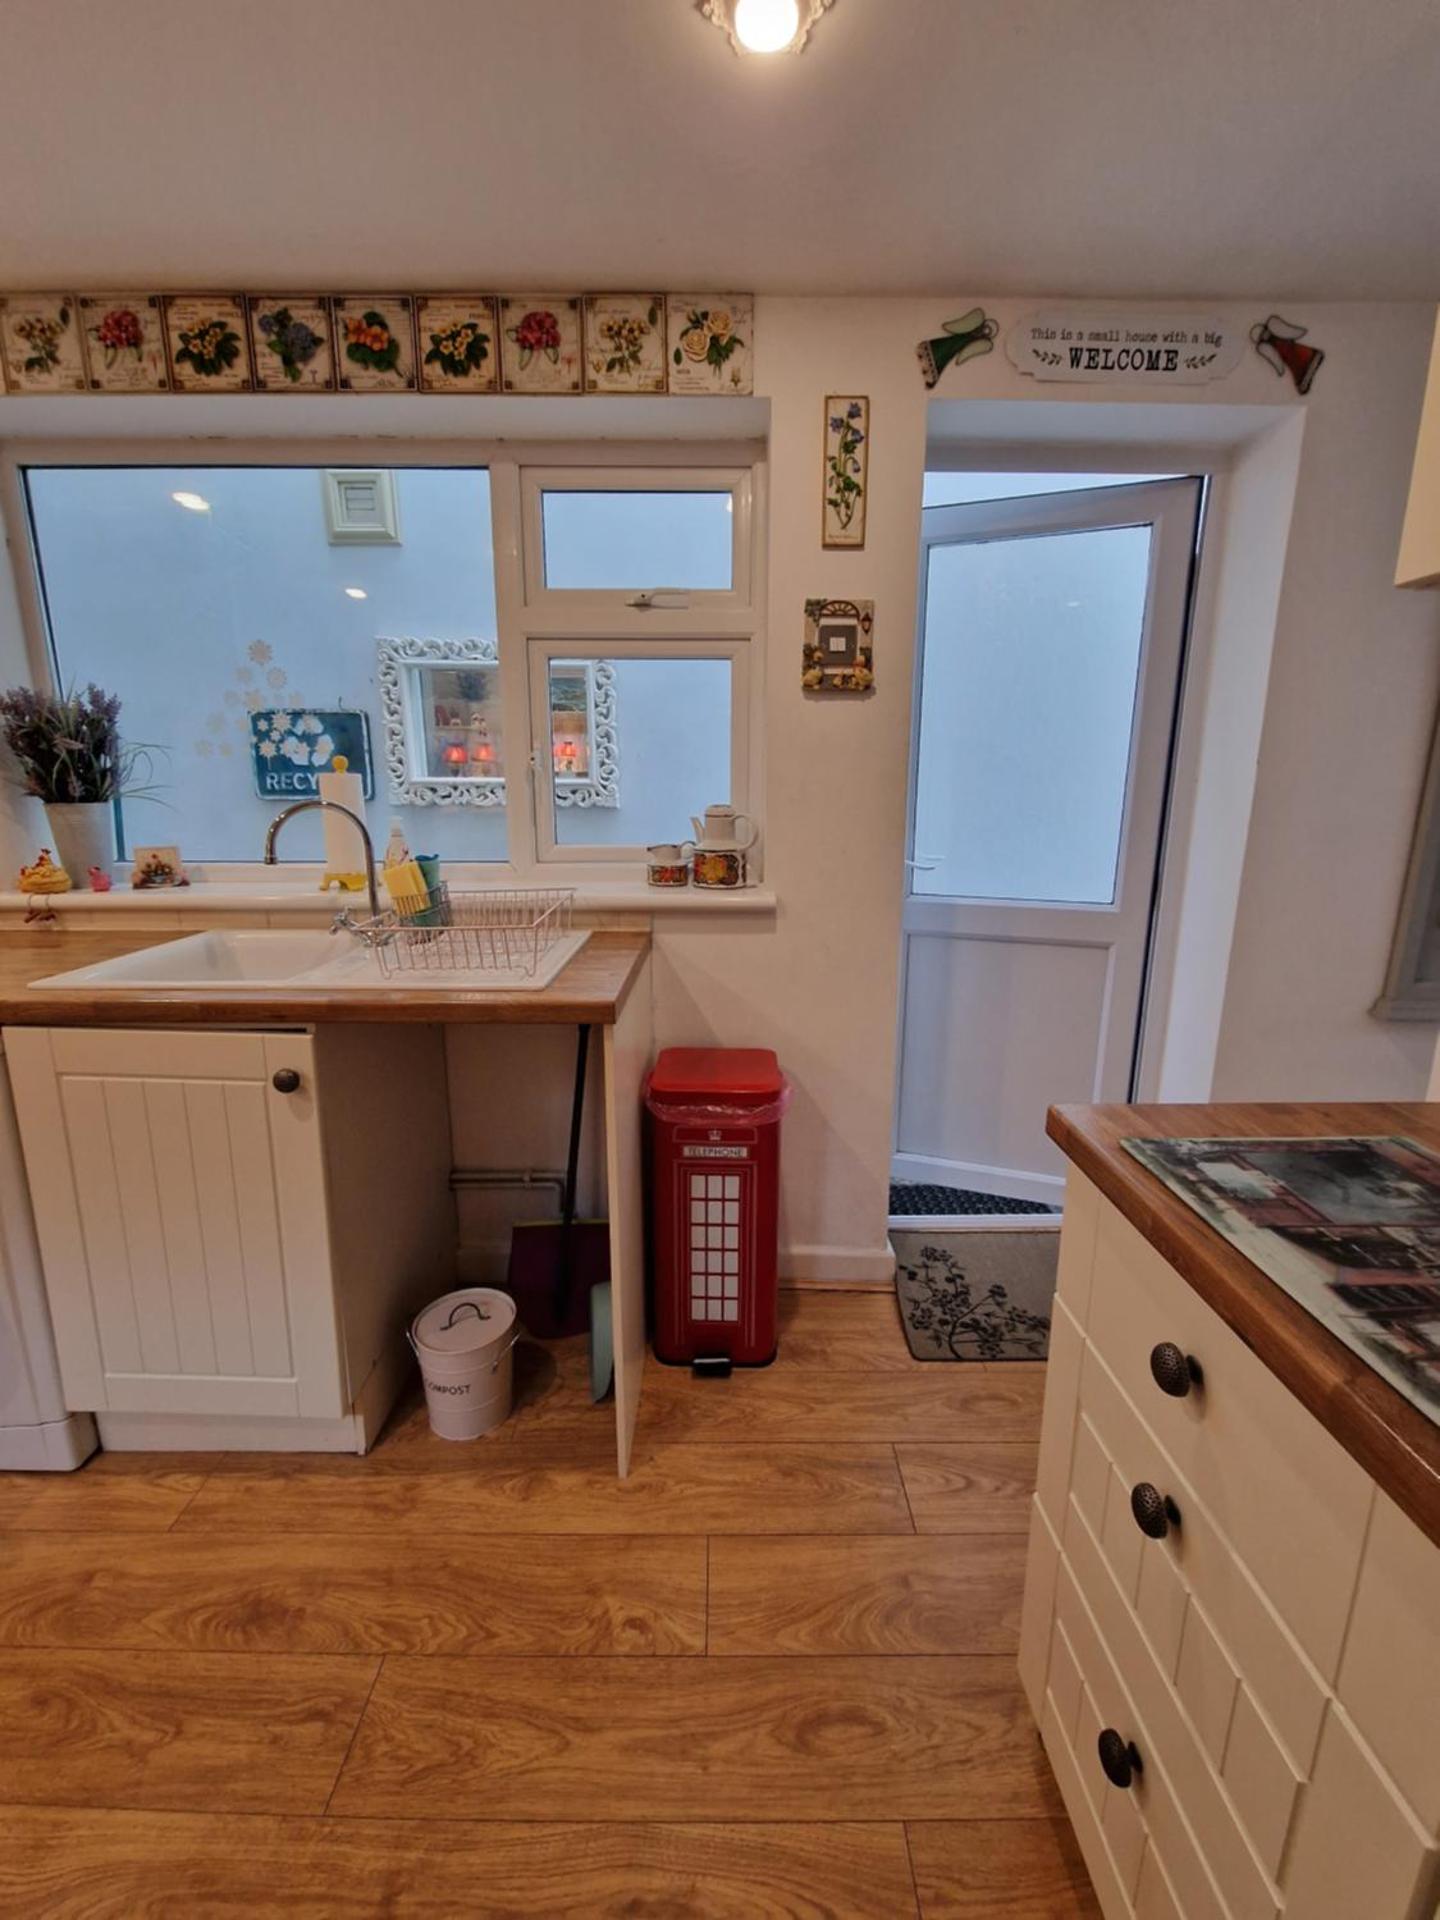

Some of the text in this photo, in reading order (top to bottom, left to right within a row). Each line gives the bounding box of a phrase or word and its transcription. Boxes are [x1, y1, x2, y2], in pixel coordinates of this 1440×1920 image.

[1031, 328, 1223, 348] This is a small house with a big
[1068, 347, 1179, 371] WELCOME
[265, 772, 318, 790] RECY
[687, 1146, 744, 1158] TELEPHONE
[426, 1380, 471, 1396] OMPOST
